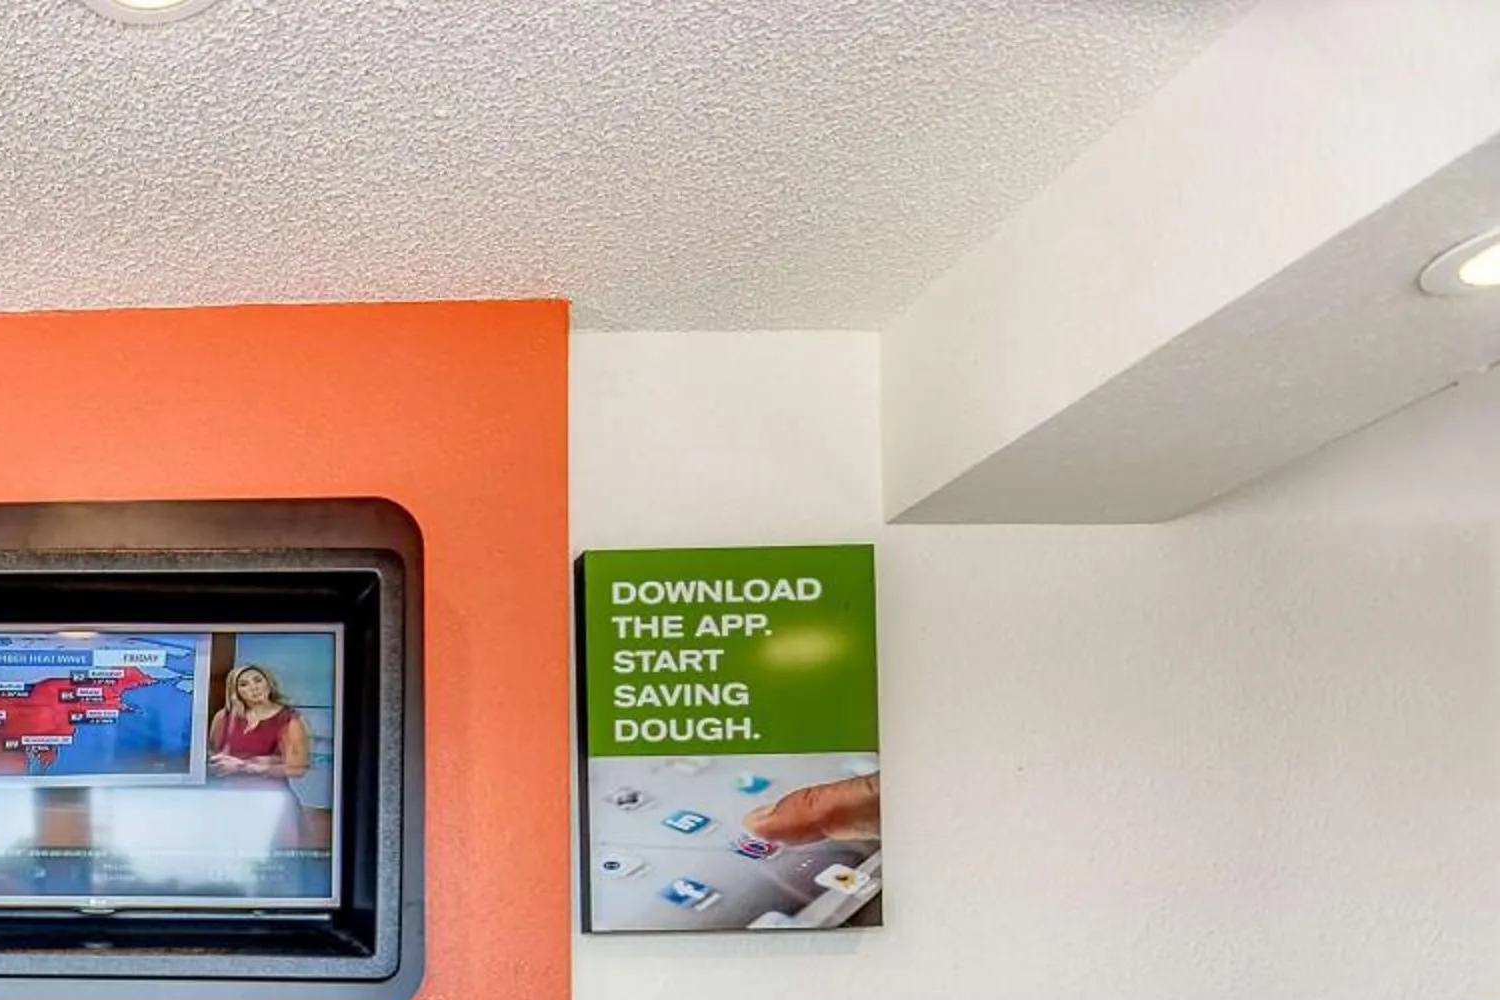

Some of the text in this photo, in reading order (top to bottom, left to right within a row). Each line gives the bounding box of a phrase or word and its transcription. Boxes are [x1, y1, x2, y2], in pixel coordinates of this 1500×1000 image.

[612, 577, 822, 605] DOWNLOAD
[611, 613, 772, 639] THE APP.
[123, 654, 158, 663] FRIDAY
[613, 649, 725, 674] START
[614, 682, 749, 708] SAVING
[614, 717, 760, 742] DOUGH.
